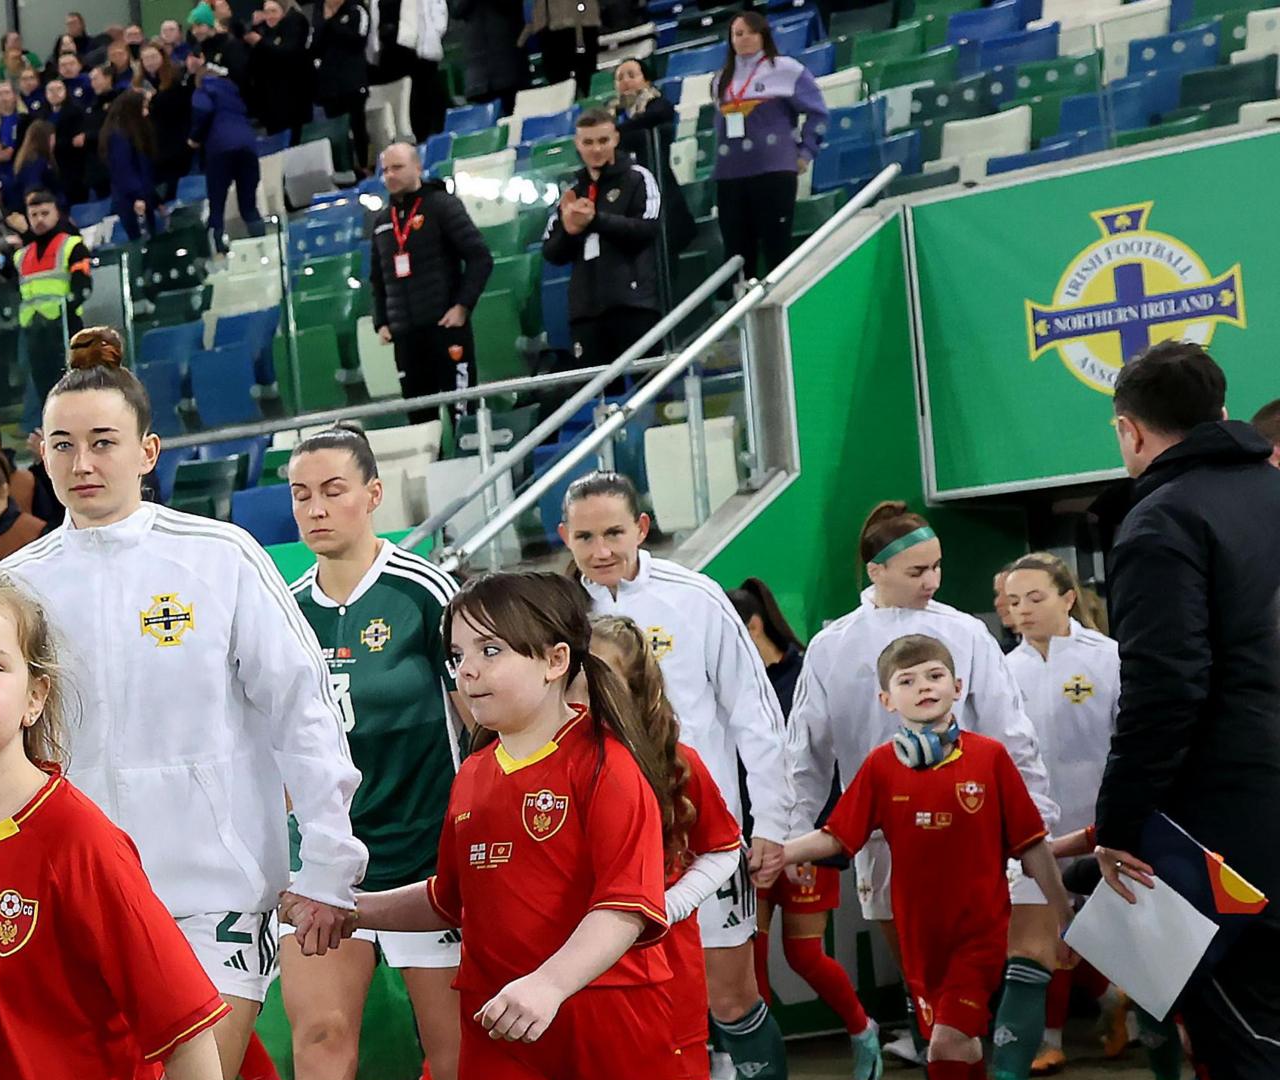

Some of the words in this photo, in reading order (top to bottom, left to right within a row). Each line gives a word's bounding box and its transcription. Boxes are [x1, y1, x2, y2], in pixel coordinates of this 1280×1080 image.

[1065, 253, 1103, 298] IRISH
[1104, 240, 1195, 282] FOOTBALL
[1054, 304, 1139, 334] NORTHERN
[1140, 293, 1214, 320] IRELAND
[23, 905, 33, 916] CG
[216, 911, 253, 944] 2
